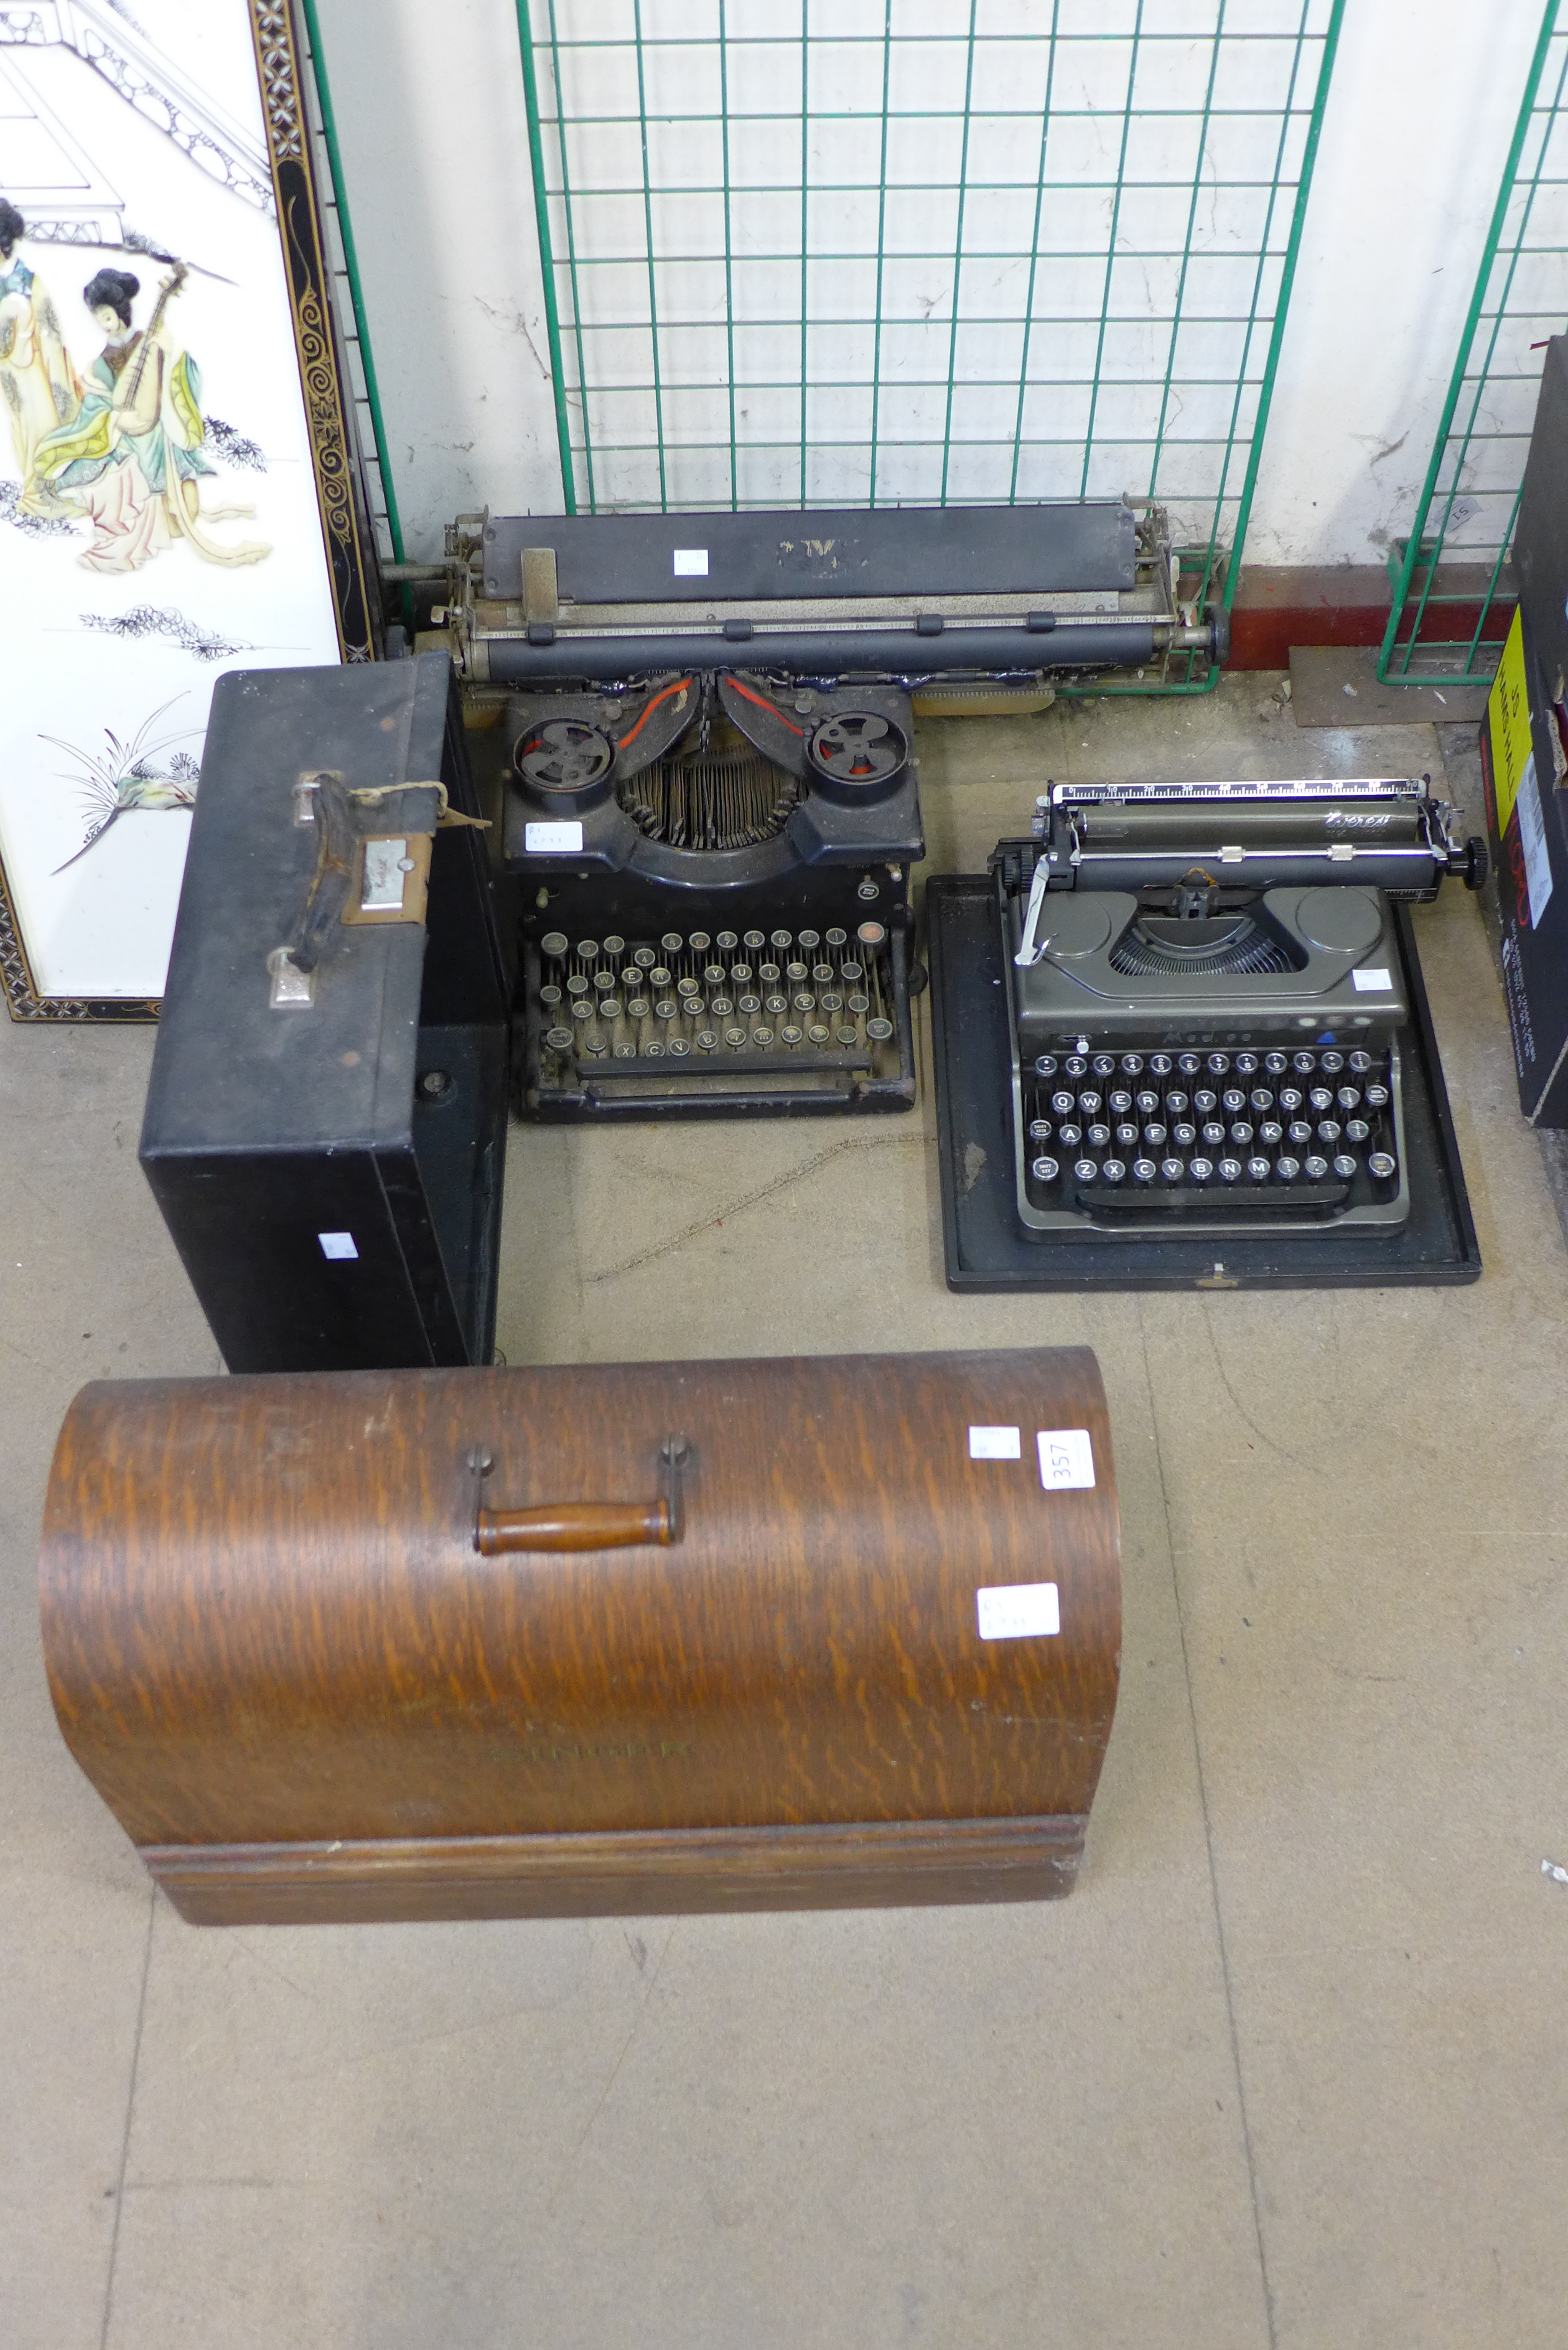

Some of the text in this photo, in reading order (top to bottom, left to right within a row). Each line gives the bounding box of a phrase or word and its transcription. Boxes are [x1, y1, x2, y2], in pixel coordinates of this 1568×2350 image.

[1511, 683, 1519, 718] JS
[1499, 661, 1514, 802] HAMS HALL
[627, 971, 635, 980] E
[712, 969, 719, 977] Y
[738, 968, 745, 976] U
[821, 968, 828, 977] P
[664, 1004, 670, 1013] F
[719, 1002, 726, 1010] H
[747, 999, 753, 1007] J
[773, 999, 780, 1007] K
[622, 1047, 629, 1056] X
[650, 1046, 658, 1054] C
[675, 1042, 683, 1051] V
[1057, 1097, 1068, 1107] Q
[1083, 1097, 1097, 1106] W
[1116, 1095, 1126, 1104] E
[1142, 1096, 1152, 1105] R
[1172, 1097, 1182, 1105] T
[1201, 1095, 1209, 1104] Y
[1228, 1095, 1239, 1103] U
[1285, 1093, 1295, 1103] O
[1317, 1093, 1326, 1102] P
[1065, 1126, 1305, 1138] A S D F G H J K L
[1080, 1162, 1265, 1174] Z X C V B N M
[1050, 1444, 1071, 1479] 357
